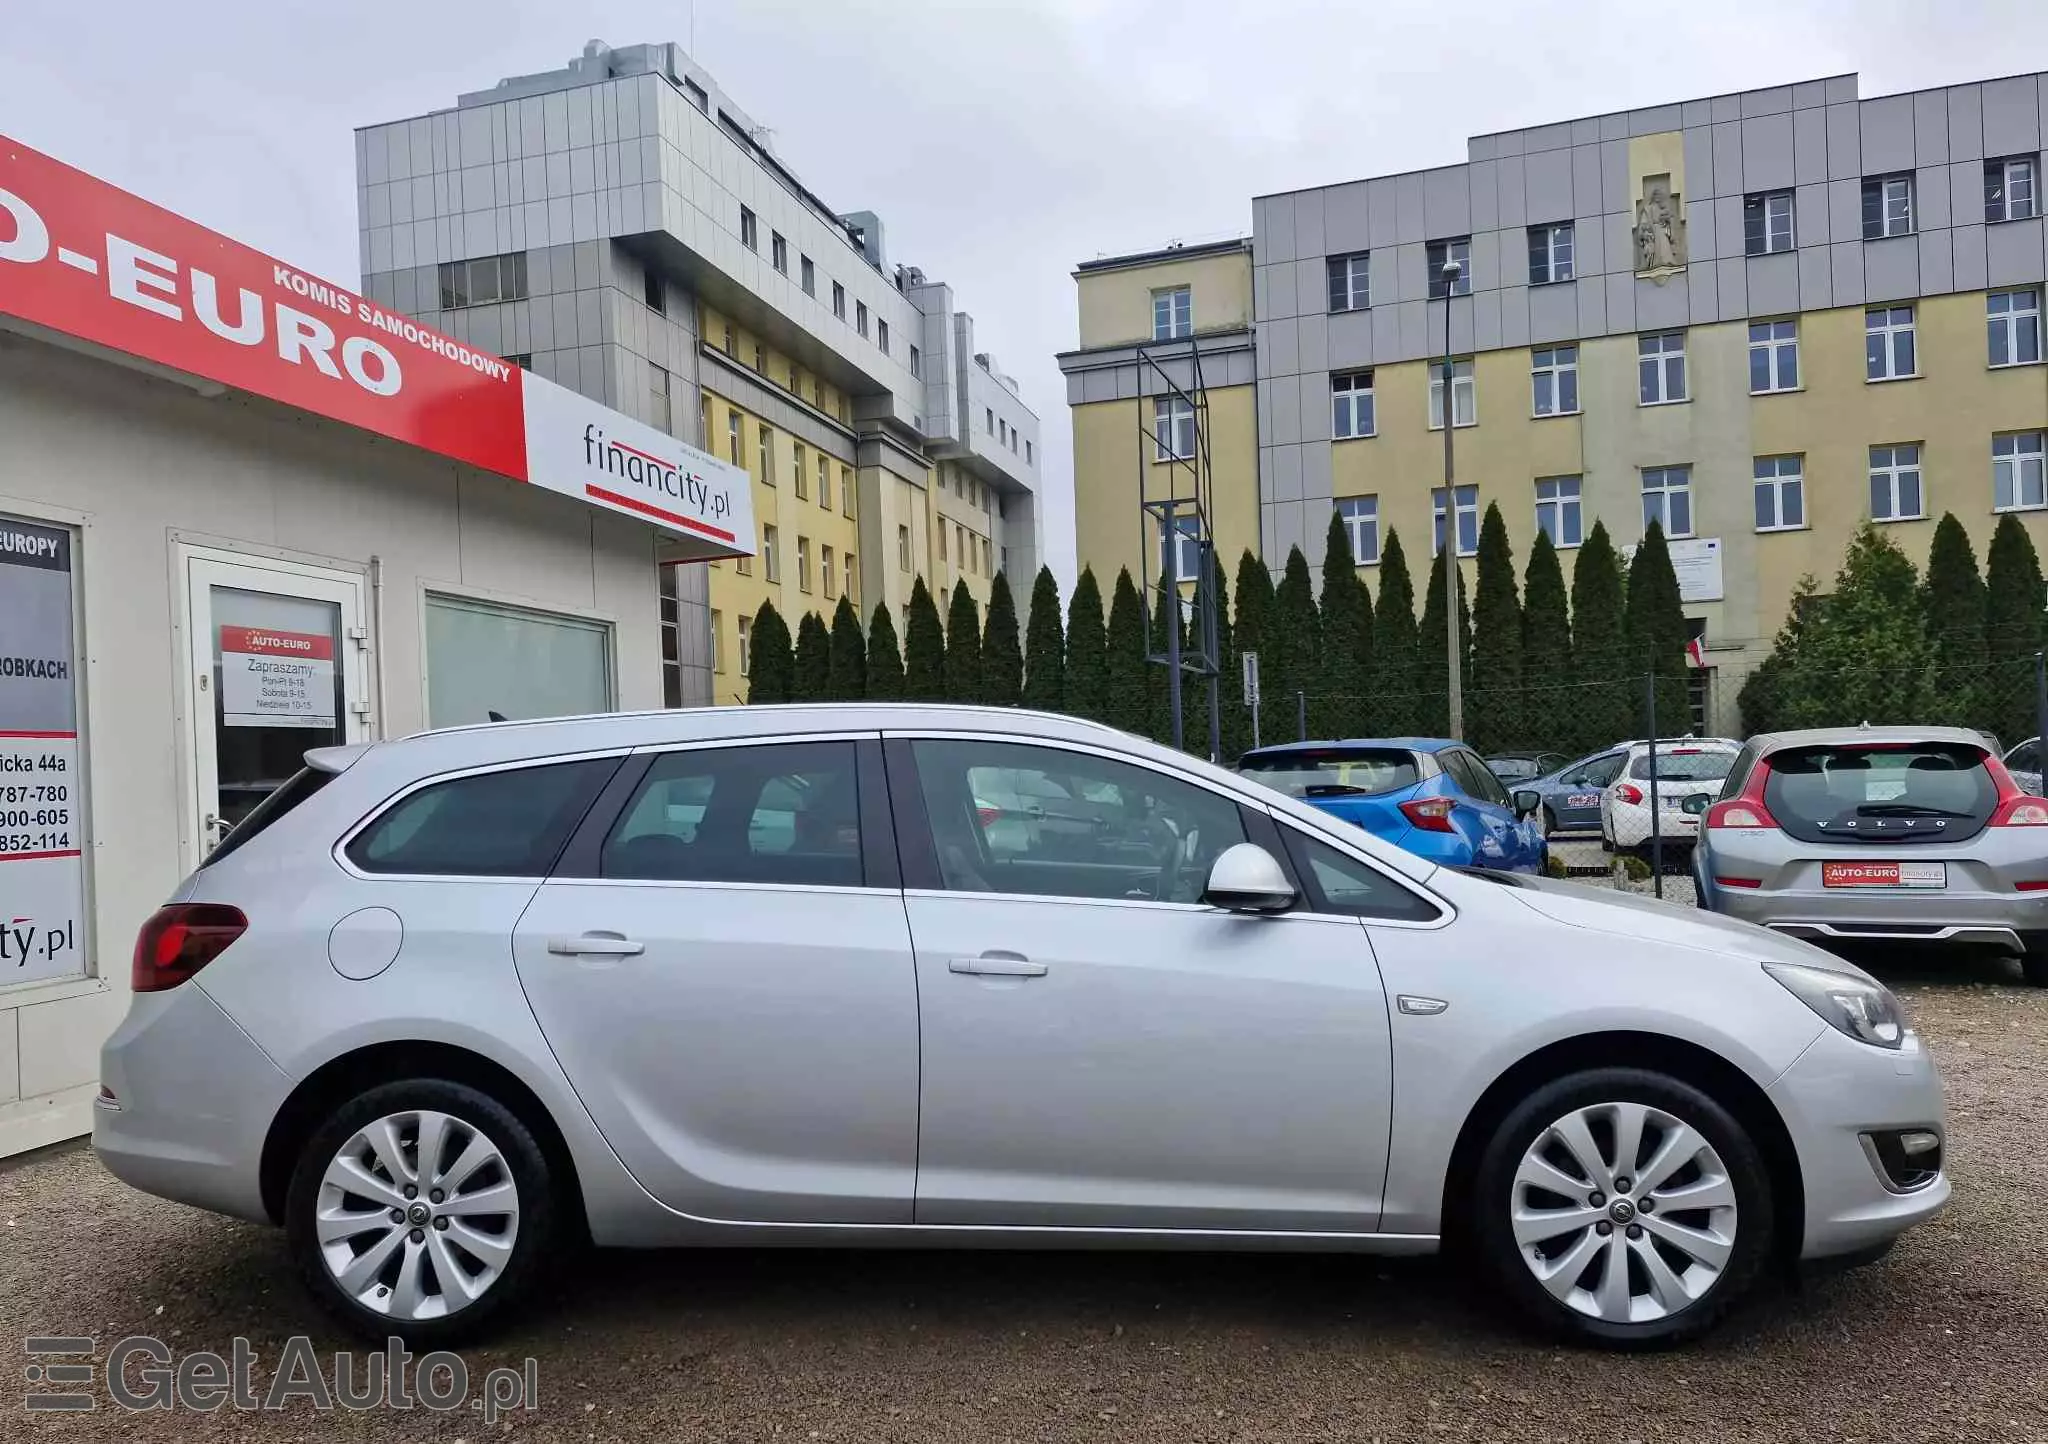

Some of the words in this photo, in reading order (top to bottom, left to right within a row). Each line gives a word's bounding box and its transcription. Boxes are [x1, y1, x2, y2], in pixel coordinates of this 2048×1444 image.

[273, 265, 351, 315] KOMIS
[358, 303, 511, 383] SAMOCHODOWY
[584, 424, 731, 519] financity.pl
[251, 636, 311, 650] AUTO-EURO
[262, 687, 288, 698] Sobota
[291, 701, 313, 710] 10-15
[38, 754, 66, 772] 44a
[1816, 820, 1947, 828] VOLVO
[0, 832, 70, 852] 852-114
[1831, 868, 1898, 878] AUTO-EURO
